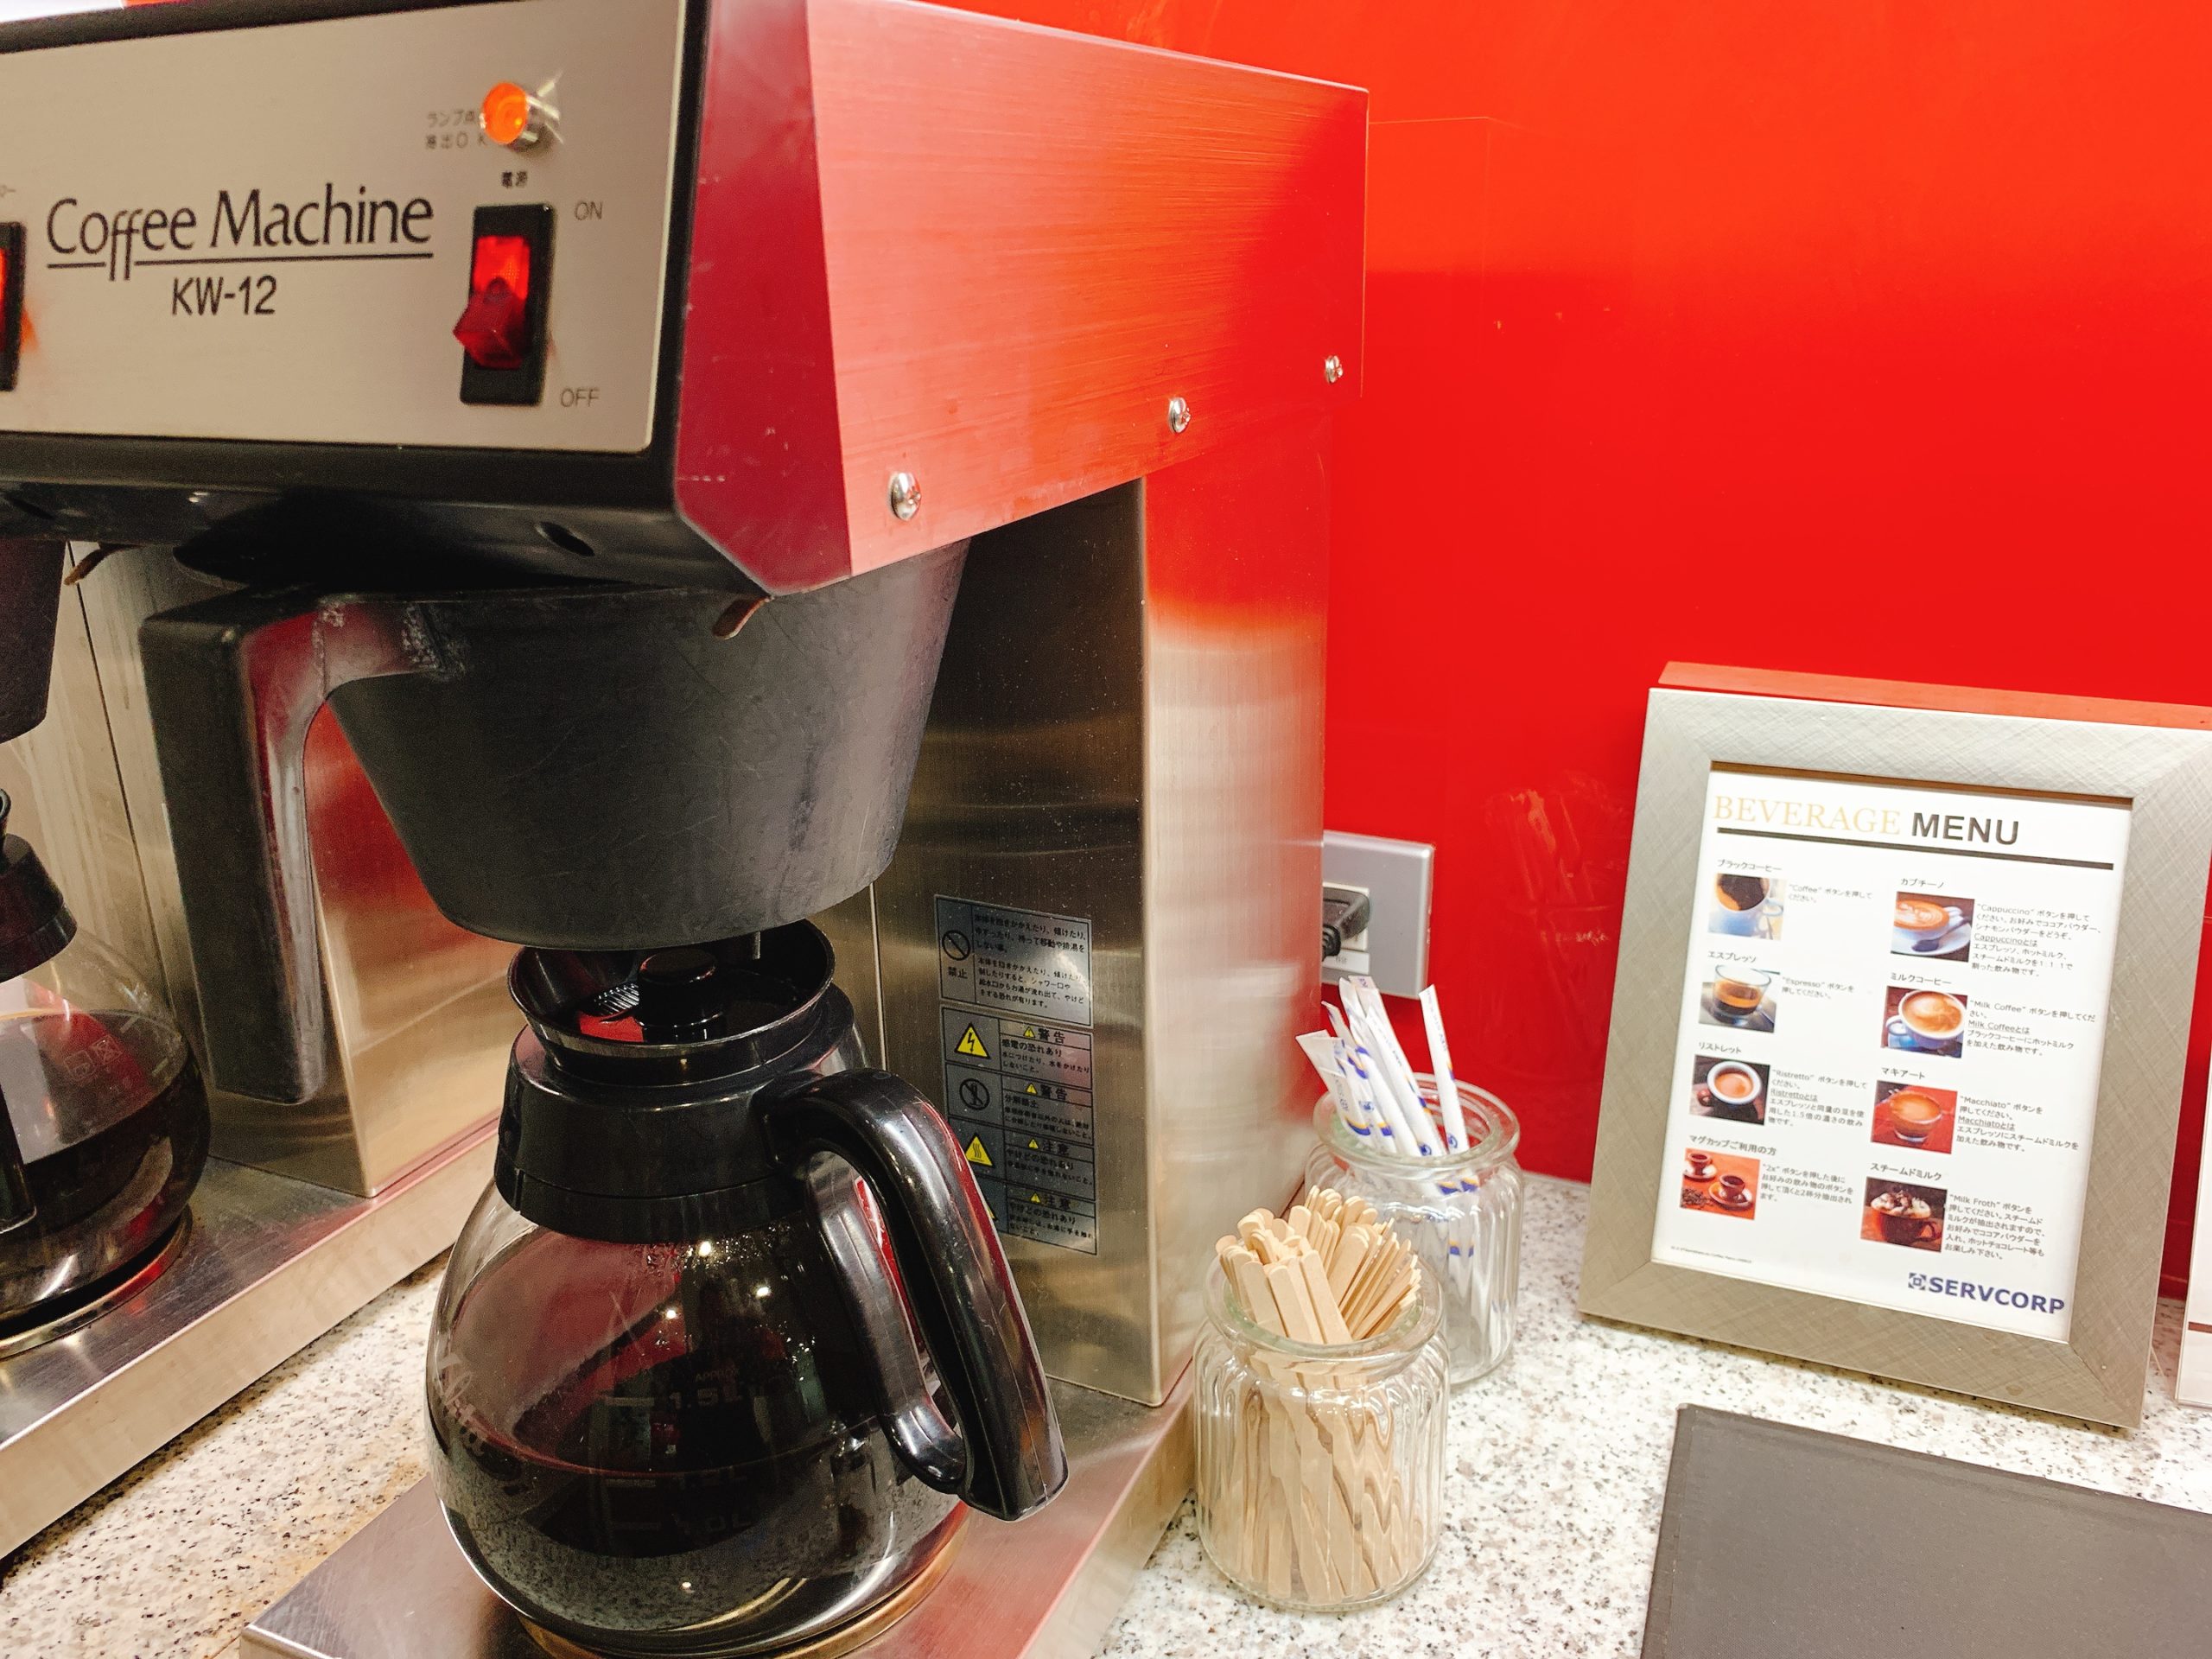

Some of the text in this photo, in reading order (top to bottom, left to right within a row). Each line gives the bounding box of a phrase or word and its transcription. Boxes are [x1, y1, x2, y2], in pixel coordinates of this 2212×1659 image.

[575, 200, 603, 221] ON
[47, 182, 434, 281] Coffee Machine
[172, 275, 277, 316] KW-12
[560, 386, 601, 407] OFF
[1713, 795, 2019, 846] BEVERAGE MENU
[1707, 950, 1757, 963] エスプレッソ
[1890, 971, 1953, 986] ミルクコーヒー
[1037, 1027, 1065, 1045] 警告
[1698, 1041, 1742, 1054] リストレット
[1881, 1067, 1926, 1080] マキアート
[1039, 1084, 1068, 1101] 警告
[1688, 1134, 1777, 1156] マグカップご利用の方
[1870, 1163, 1942, 1181] スチームドミルク
[1928, 1276, 2066, 1314] SERVCORP
